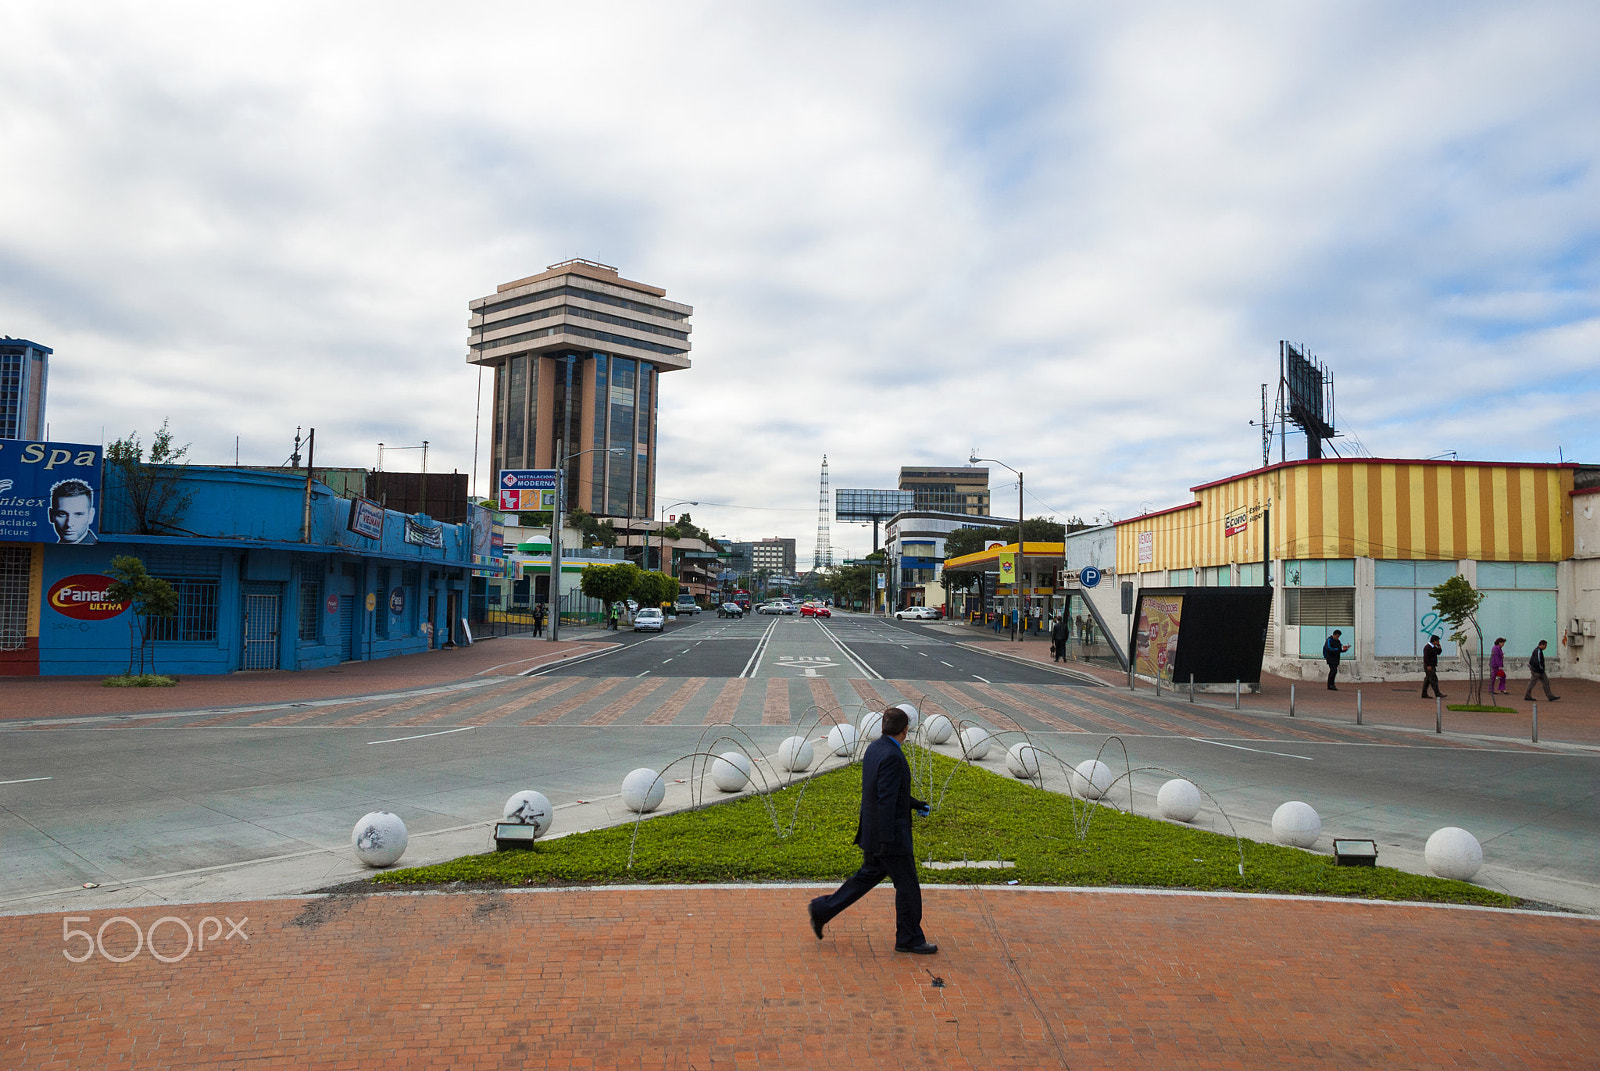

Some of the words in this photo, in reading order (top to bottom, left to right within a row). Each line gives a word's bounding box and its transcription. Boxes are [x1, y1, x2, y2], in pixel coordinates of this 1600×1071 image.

[20, 443, 96, 470] Spa
[1086, 570, 1097, 583] P
[89, 603, 122, 611] ULTRA
